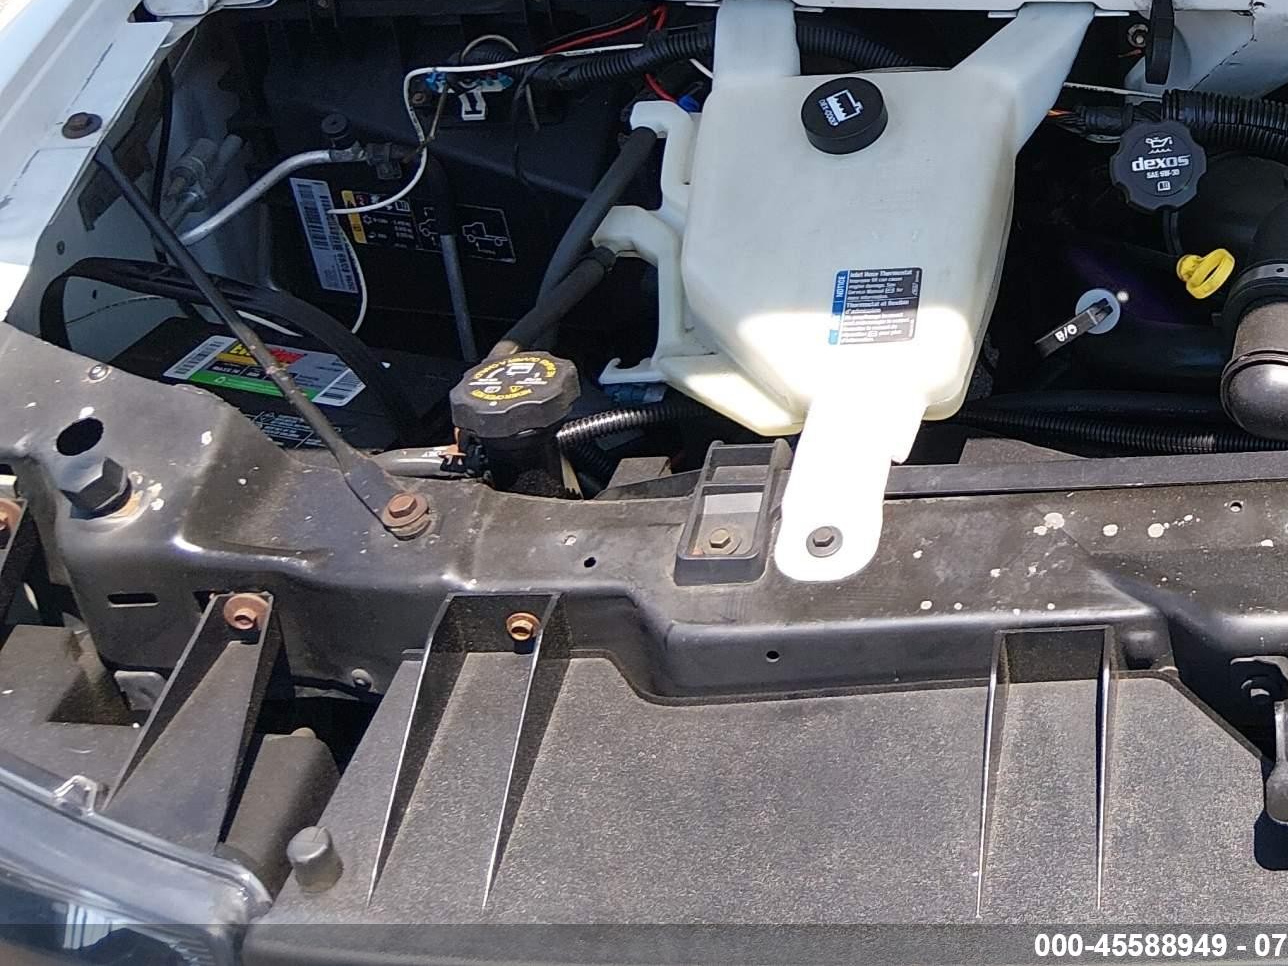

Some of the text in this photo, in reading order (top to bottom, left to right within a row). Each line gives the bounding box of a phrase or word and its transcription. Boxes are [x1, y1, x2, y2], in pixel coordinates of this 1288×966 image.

[1131, 154, 1192, 172] dexos
[1146, 168, 1180, 179] SAE 5W-30
[835, 275, 846, 298] NOTICE
